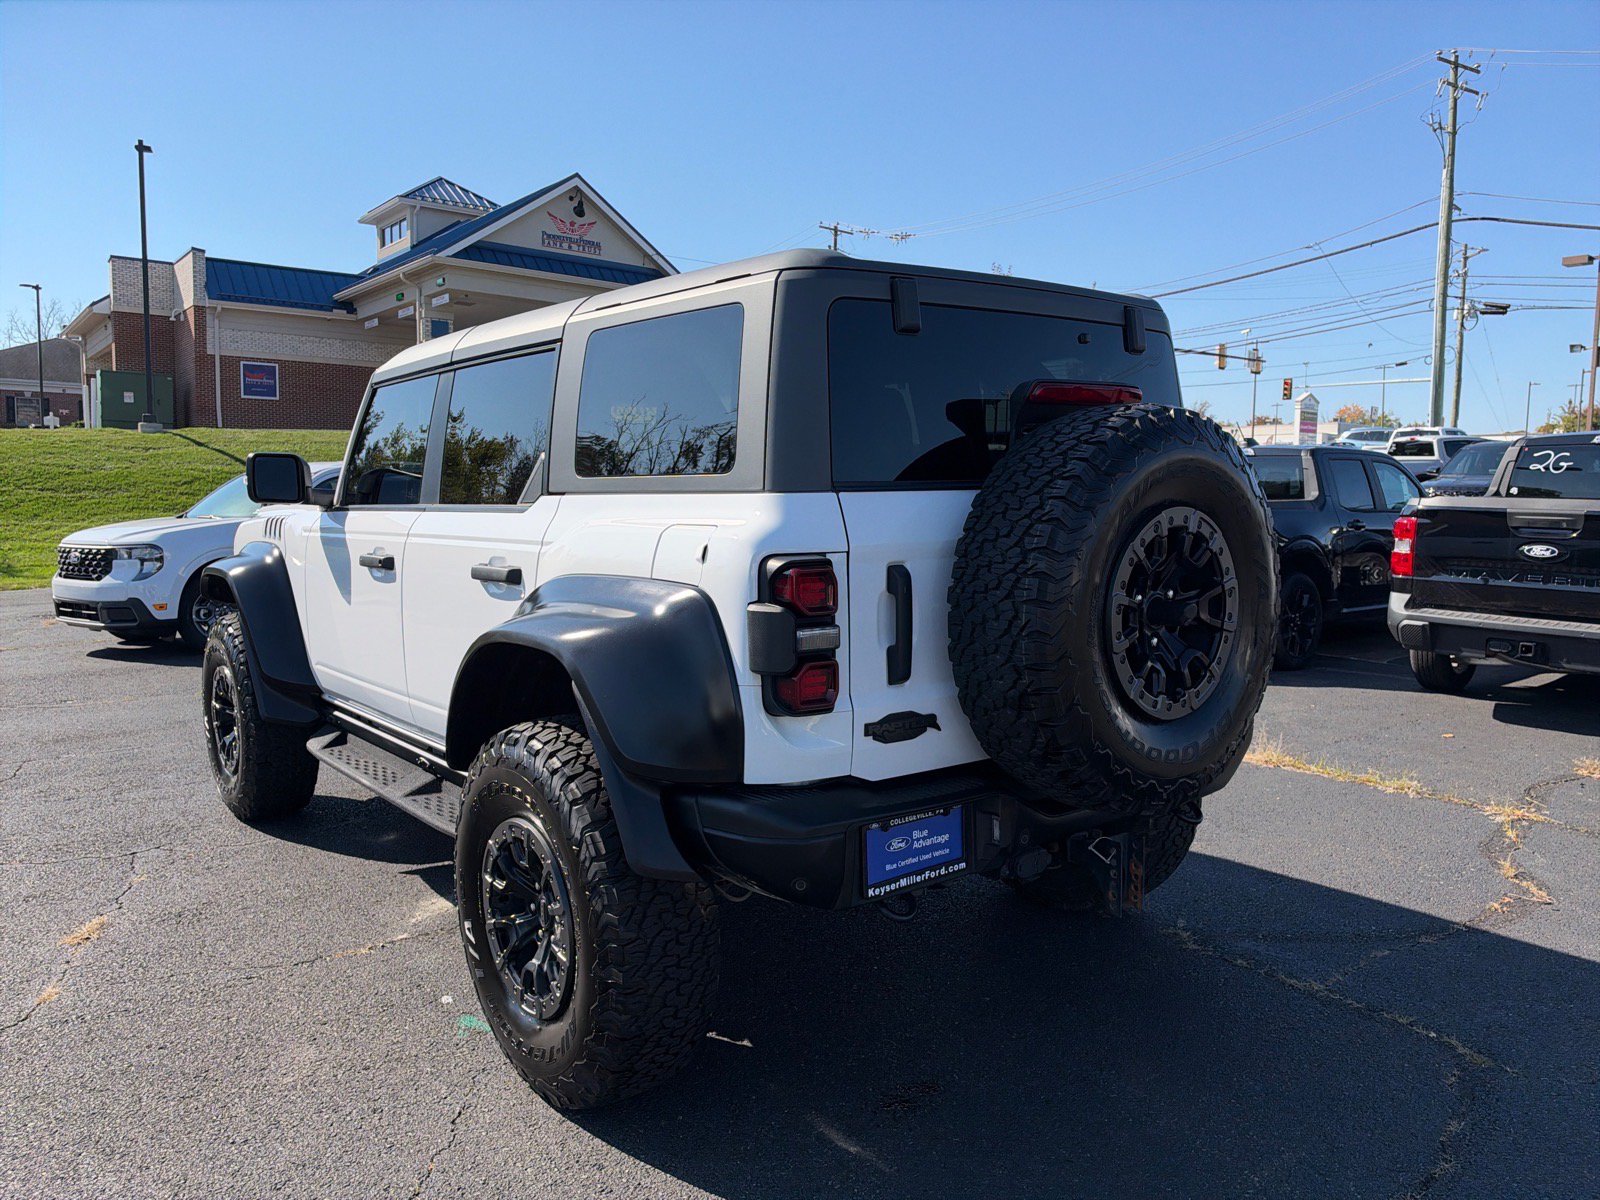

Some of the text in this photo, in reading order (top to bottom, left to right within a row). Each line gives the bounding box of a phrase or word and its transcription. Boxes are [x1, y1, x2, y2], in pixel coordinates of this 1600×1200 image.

[577, 244, 602, 256] TRUST
[1448, 567, 1600, 587] MAVERI
[912, 829, 929, 840] Blue
[912, 833, 950, 849] Advantage
[888, 838, 908, 850] Ford
[885, 848, 950, 871] Blue Certified Used Vehicle
[868, 861, 967, 897] KeyserMillerFord.com
